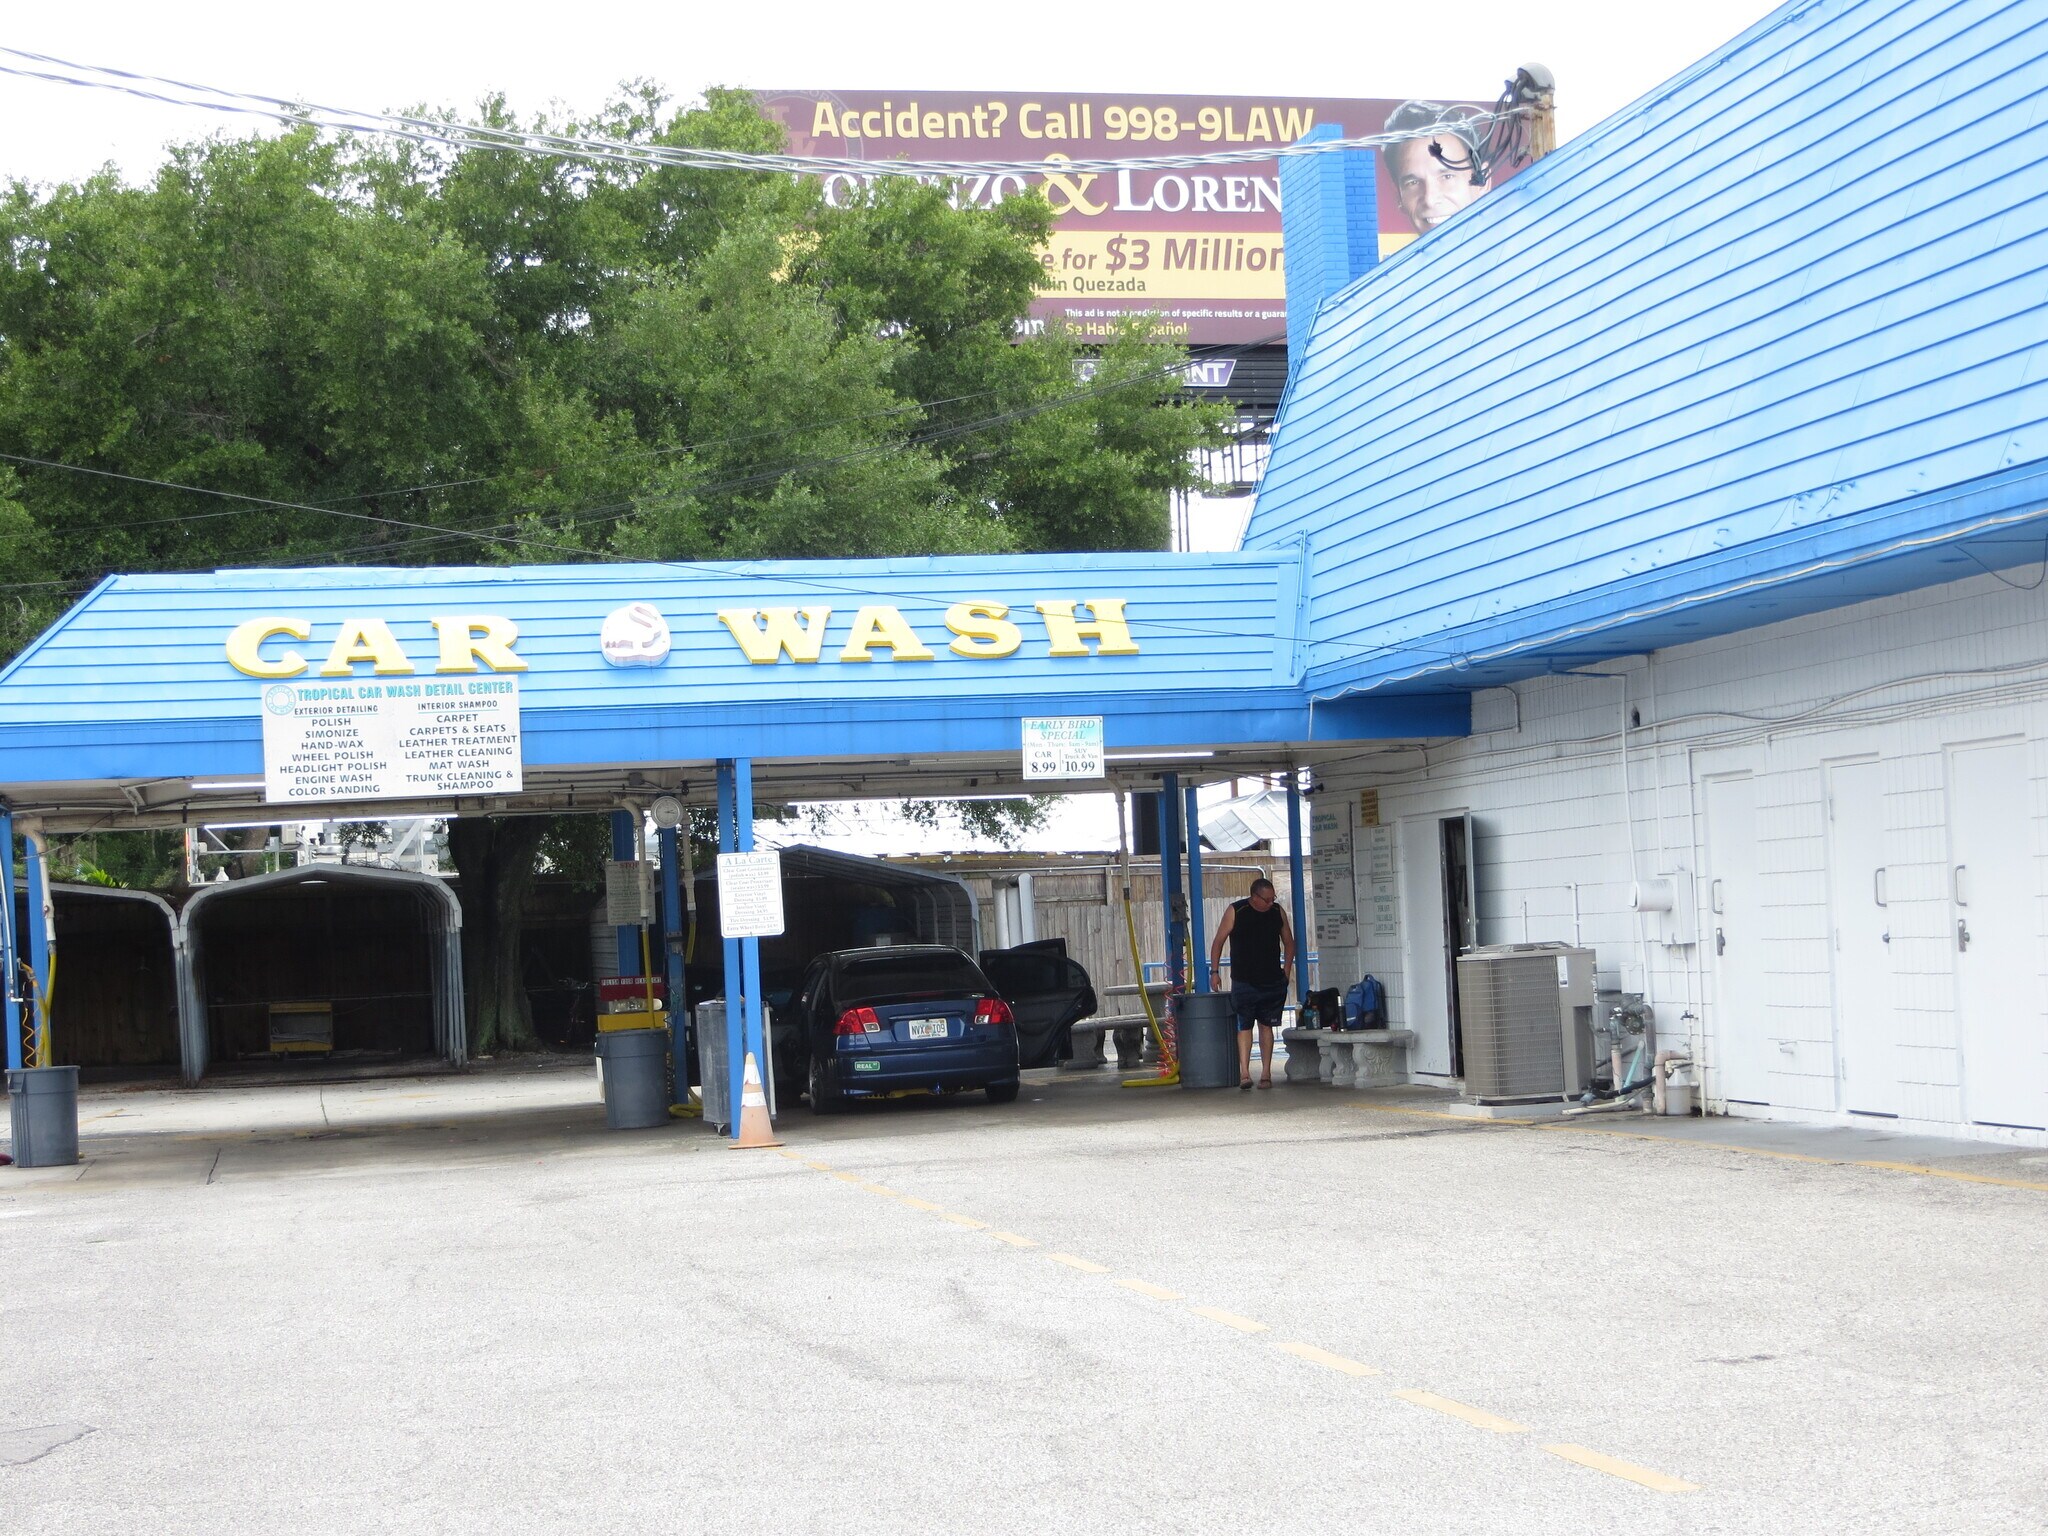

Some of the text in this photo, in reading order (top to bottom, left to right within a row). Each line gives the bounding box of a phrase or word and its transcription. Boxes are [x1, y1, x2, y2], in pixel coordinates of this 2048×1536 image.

[811, 101, 1314, 143] Accident? Call 998-9LAW
[1062, 247, 1098, 270] for
[1105, 233, 1150, 276] $3
[1073, 276, 1146, 294] Quezada
[1064, 308, 1083, 317] This
[1085, 308, 1095, 317] ad
[1097, 308, 1105, 317] is
[1106, 309, 1120, 317] not
[1171, 308, 1181, 317] of
[1182, 308, 1213, 320] specific
[1214, 309, 1243, 318] results
[226, 599, 1140, 679] CAR WASH
[297, 680, 514, 702] TROPICAL CAR WASH DETAIL CENTER
[294, 704, 379, 716] EXTERIOR DETAILING
[417, 700, 498, 711] INTERIOR SHAMPOO
[312, 718, 351, 728] POLISH
[436, 713, 479, 723] CARPET
[409, 724, 507, 736] CARPETS & SEATS
[1030, 719, 1095, 730] EARLY BIRD
[305, 728, 359, 739] SIMONIZE
[1040, 730, 1086, 741] SPECIAL
[301, 739, 364, 750] HAND-WAX
[399, 735, 518, 748] LEATHER TREATMENT
[291, 751, 374, 763] WHEEL POLISH
[405, 746, 513, 760] LEATHER CLEANING
[1034, 750, 1052, 758] CAR
[280, 761, 387, 774] HEADLIGHT POLISH
[429, 759, 490, 770] MAT WASH
[295, 773, 373, 785] ENGINE WASH
[406, 770, 514, 783] TRUNK CLEANING &
[288, 785, 381, 797] COLOR SANDING
[437, 780, 494, 791] SHAMPOO
[725, 856, 773, 866] A La Carte
